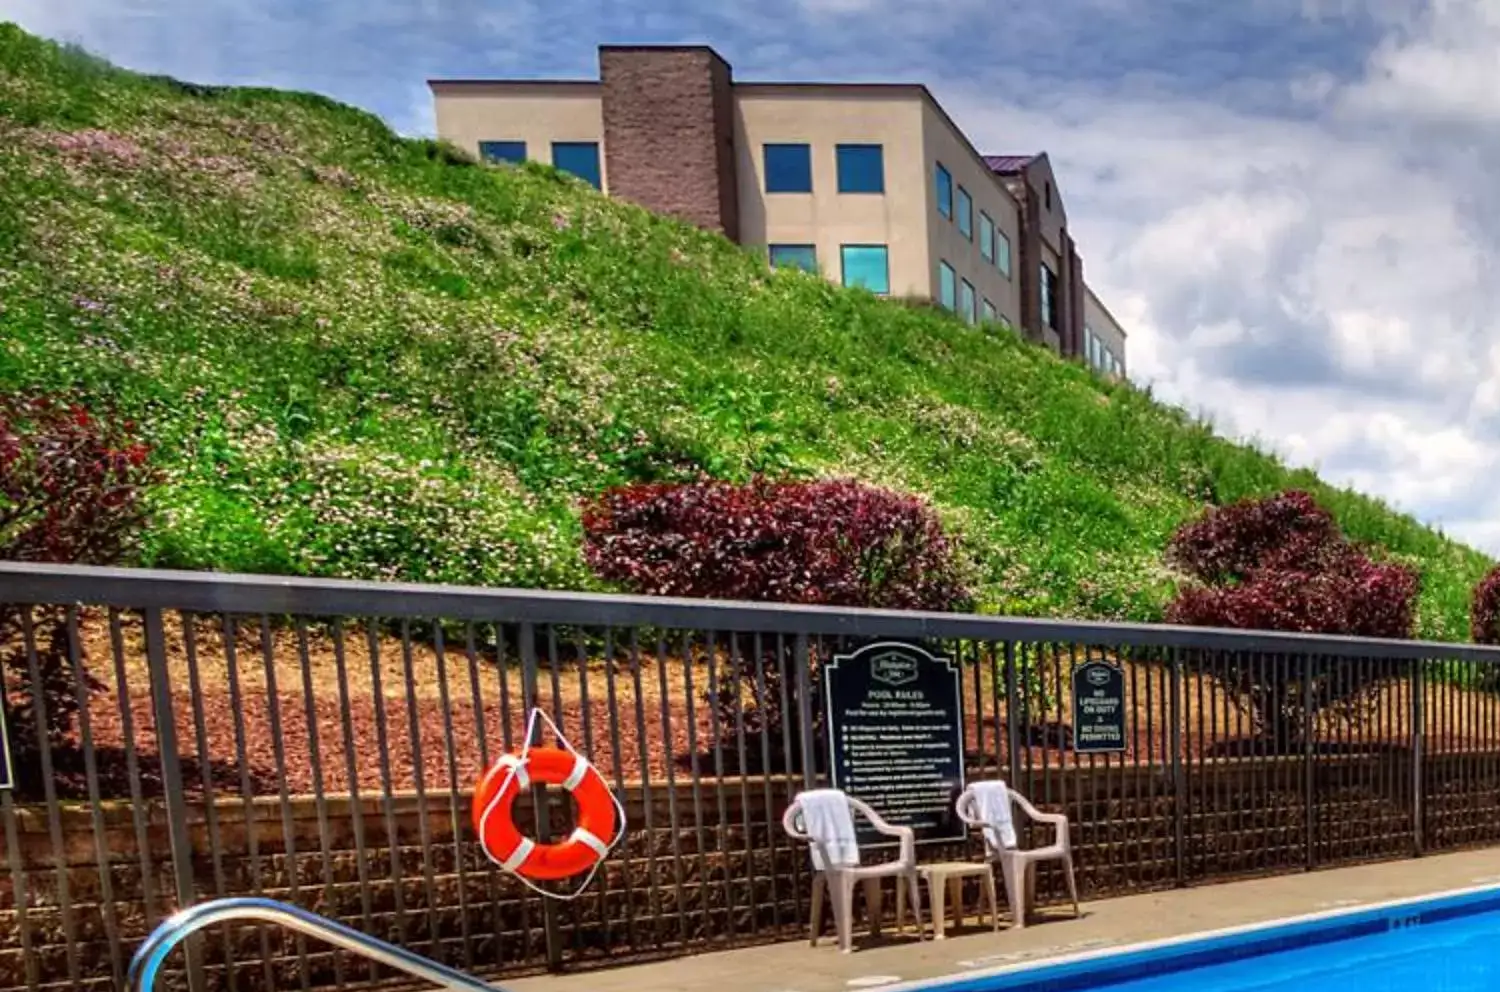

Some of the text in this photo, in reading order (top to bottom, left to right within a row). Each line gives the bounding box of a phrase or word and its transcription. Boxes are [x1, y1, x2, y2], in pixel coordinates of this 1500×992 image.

[868, 690, 924, 699] POOL RULES
[1096, 706, 1115, 714] DUTY
